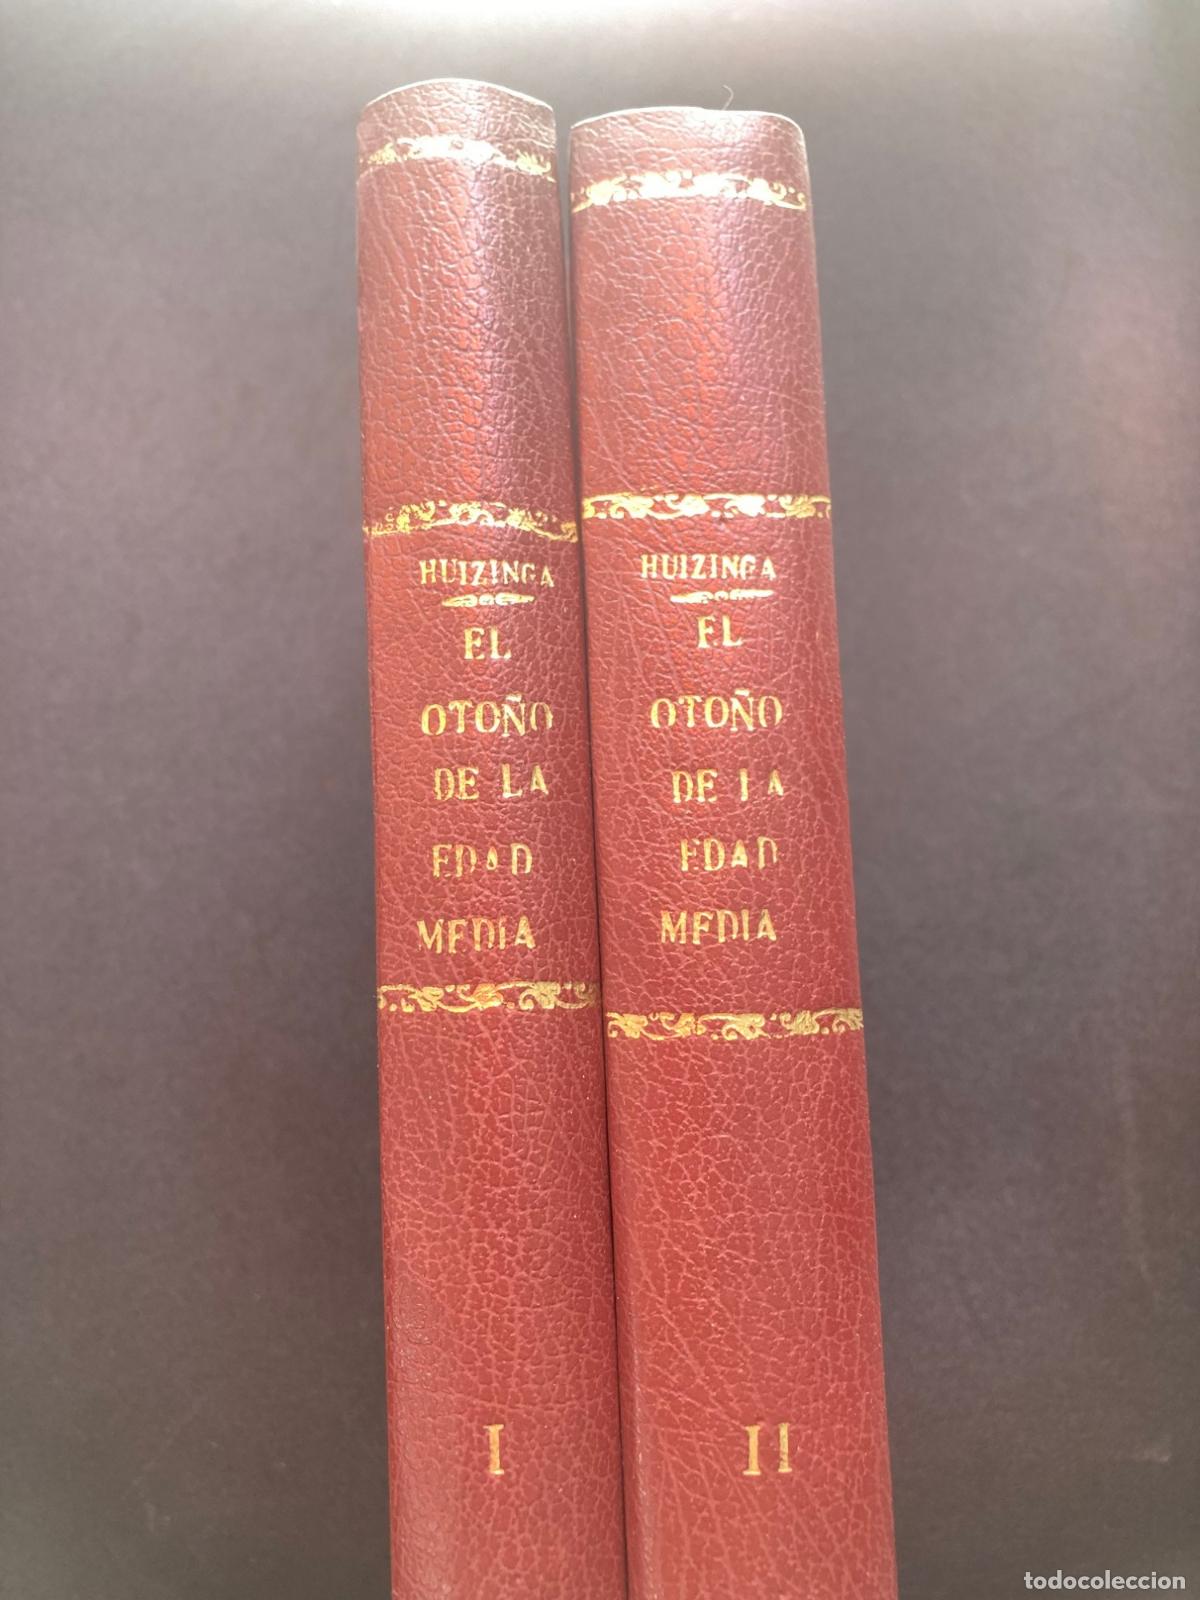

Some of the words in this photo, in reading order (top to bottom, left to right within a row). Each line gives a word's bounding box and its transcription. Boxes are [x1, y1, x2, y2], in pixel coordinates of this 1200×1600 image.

[419, 558, 555, 587] HUIZINGA
[640, 553, 777, 581] HUIZINGA
[464, 626, 512, 660] EL
[697, 615, 743, 648] EL
[420, 693, 554, 737] OTOÑO
[650, 688, 783, 732] OTOÑO
[434, 767, 480, 801] DE
[501, 763, 549, 799] LA
[672, 768, 718, 803] DE
[483, 1423, 505, 1476] I
[743, 1422, 793, 1476] II
